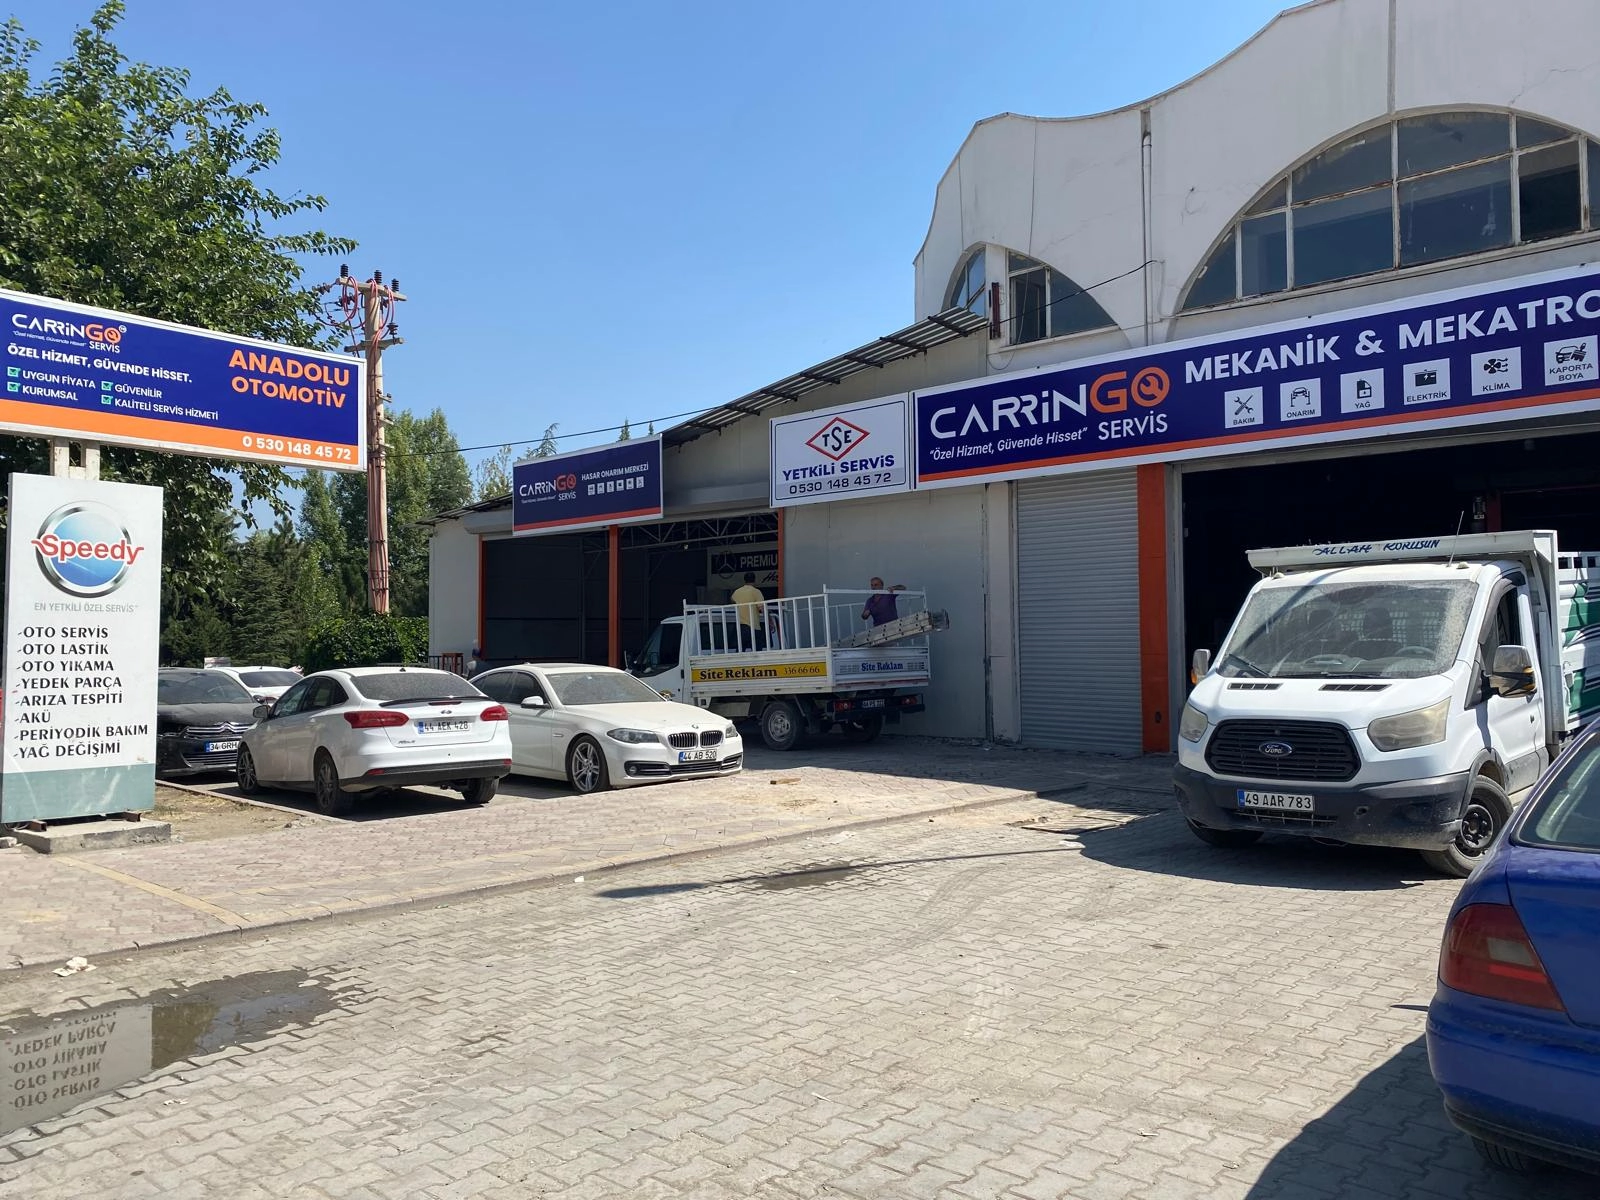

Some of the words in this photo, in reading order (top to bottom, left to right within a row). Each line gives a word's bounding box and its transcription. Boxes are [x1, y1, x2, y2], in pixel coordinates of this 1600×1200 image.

[1185, 333, 1340, 384] MEKANİK
[1355, 330, 1385, 356] &
[1399, 289, 1600, 350] MEKATRO
[89, 341, 120, 353] SERVİS
[7, 343, 39, 359] ÖZEL
[42, 348, 91, 368] HİZMET,
[93, 357, 149, 376] GÜVENDE
[152, 367, 193, 383] HİSSET.
[229, 350, 349, 386] ANADOLU
[1549, 363, 1593, 375] KAPORTA
[23, 370, 59, 384] UYGUN
[61, 374, 96, 389] FİYATA
[1559, 373, 1584, 382] BOYA
[23, 385, 78, 401] KURUMSAL
[114, 383, 163, 398] GÜVENİLİR
[231, 376, 346, 408] OTOMOTİV
[1482, 382, 1510, 392] KLİMA
[1406, 390, 1447, 403] ELEKTRİK
[114, 398, 151, 411] KALİTELİ
[153, 403, 183, 416] SERVİS
[185, 407, 219, 420] HİZMETİ
[1286, 409, 1315, 418] ONARIM
[1098, 410, 1168, 440] SERVİS
[1233, 417, 1255, 426] BAKIM
[822, 426, 852, 452] TSE
[242, 436, 252, 447] 0
[256, 438, 284, 451] 530
[287, 441, 311, 455] 148
[315, 446, 333, 458] 45
[336, 448, 351, 460] 72
[957, 442, 994, 457] Hizmet,
[998, 435, 1043, 451] Güvende
[581, 471, 600, 481] HASAR
[601, 467, 624, 478] ONARIM
[624, 461, 648, 474] MERKEZİ
[827, 478, 849, 489] 148
[31, 534, 144, 565] Speedy
[1312, 545, 1372, 555] ALLAH
[1383, 540, 1440, 551] KORUSUN
[34, 602, 46, 611] EN
[48, 602, 81, 612] YETKİLİ
[84, 602, 104, 612] ÖZEL
[61, 625, 109, 638] SERVİS
[61, 641, 109, 655] LASTİK
[60, 660, 114, 671] YIKAMA
[861, 662, 875, 672] Site
[877, 661, 903, 671] Reklam
[700, 668, 723, 680] Site
[725, 667, 778, 679] Reklam
[75, 677, 122, 690] PARÇA
[72, 691, 122, 704] TESPİTİ
[105, 724, 148, 737] BAKIM
[424, 722, 434, 731] 44
[438, 721, 451, 731] AEK
[55, 740, 120, 758] DEĞİŞİMİ
[694, 751, 703, 760] AB
[705, 750, 716, 759] 520
[1245, 793, 1259, 805] 49
[1263, 794, 1284, 807] AAR
[1288, 796, 1311, 809] 783
